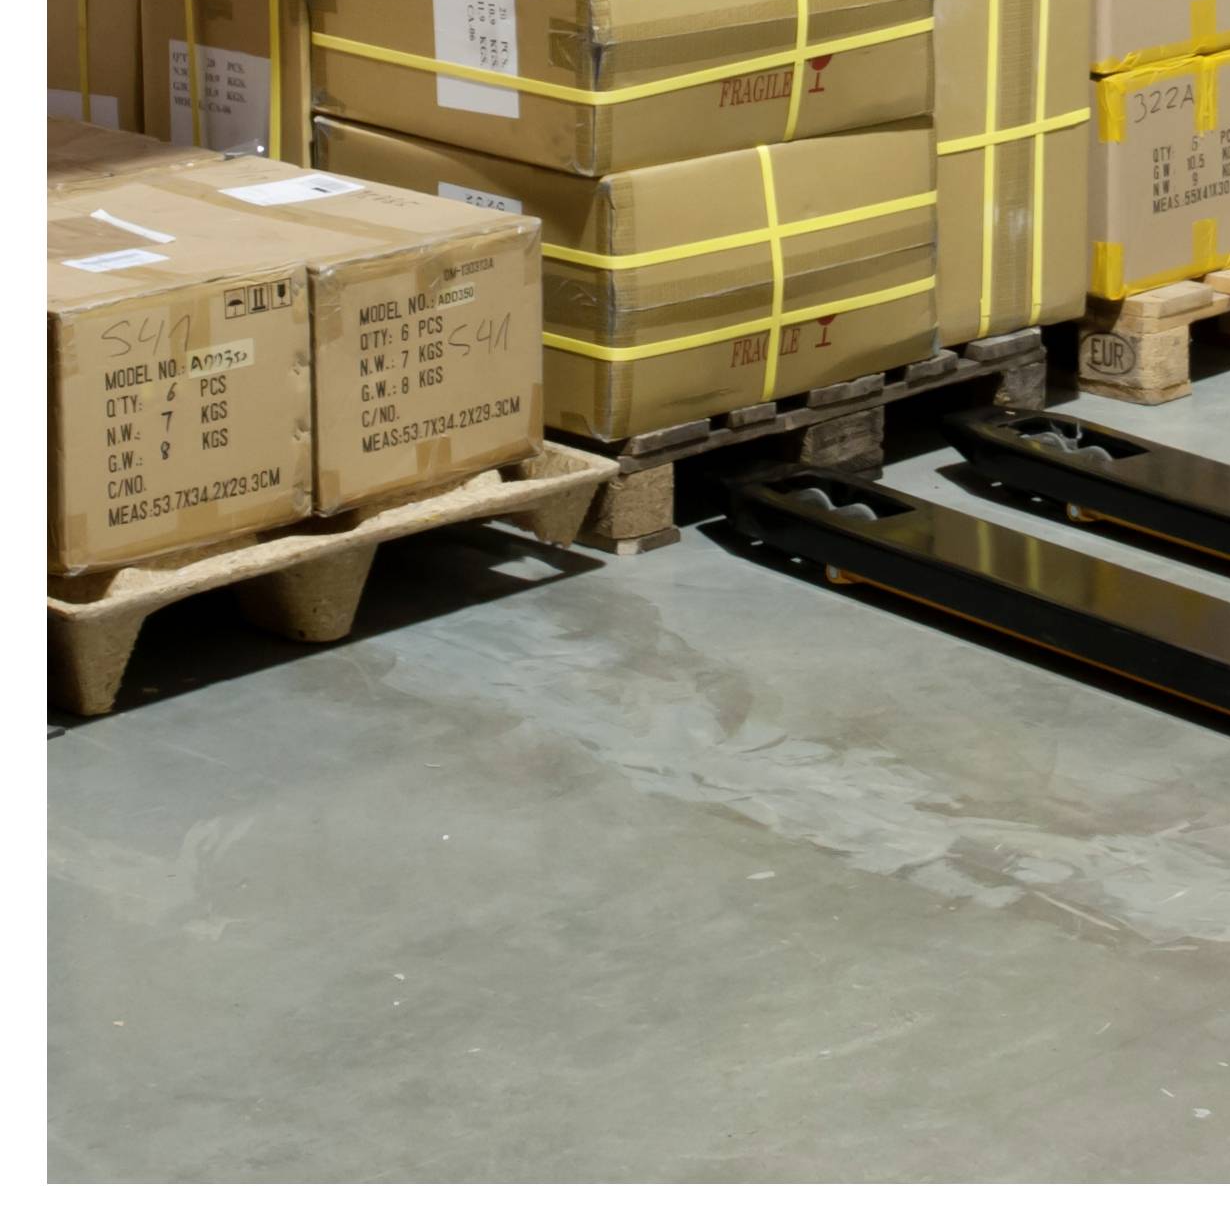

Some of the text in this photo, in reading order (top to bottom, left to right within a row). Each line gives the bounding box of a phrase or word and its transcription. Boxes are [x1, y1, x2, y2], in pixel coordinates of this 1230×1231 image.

[719, 70, 794, 107] FRAGILE
[1134, 84, 1195, 123] 322A
[359, 301, 403, 326] MODEL
[401, 326, 409, 342] 6
[418, 316, 443, 338] PCS
[402, 351, 409, 368] 7
[419, 340, 444, 363] KGS
[1090, 337, 1124, 370] EUR
[105, 364, 152, 390] MODEL
[166, 382, 177, 402] 6
[200, 375, 227, 397] PCS
[401, 376, 409, 394] 8
[419, 366, 444, 388] KGS
[160, 411, 174, 432] 7
[201, 401, 228, 424] KGS
[361, 404, 400, 428] C/NO.
[160, 441, 171, 460] 8
[202, 428, 229, 450] KGS
[107, 475, 147, 499] C/NO.
